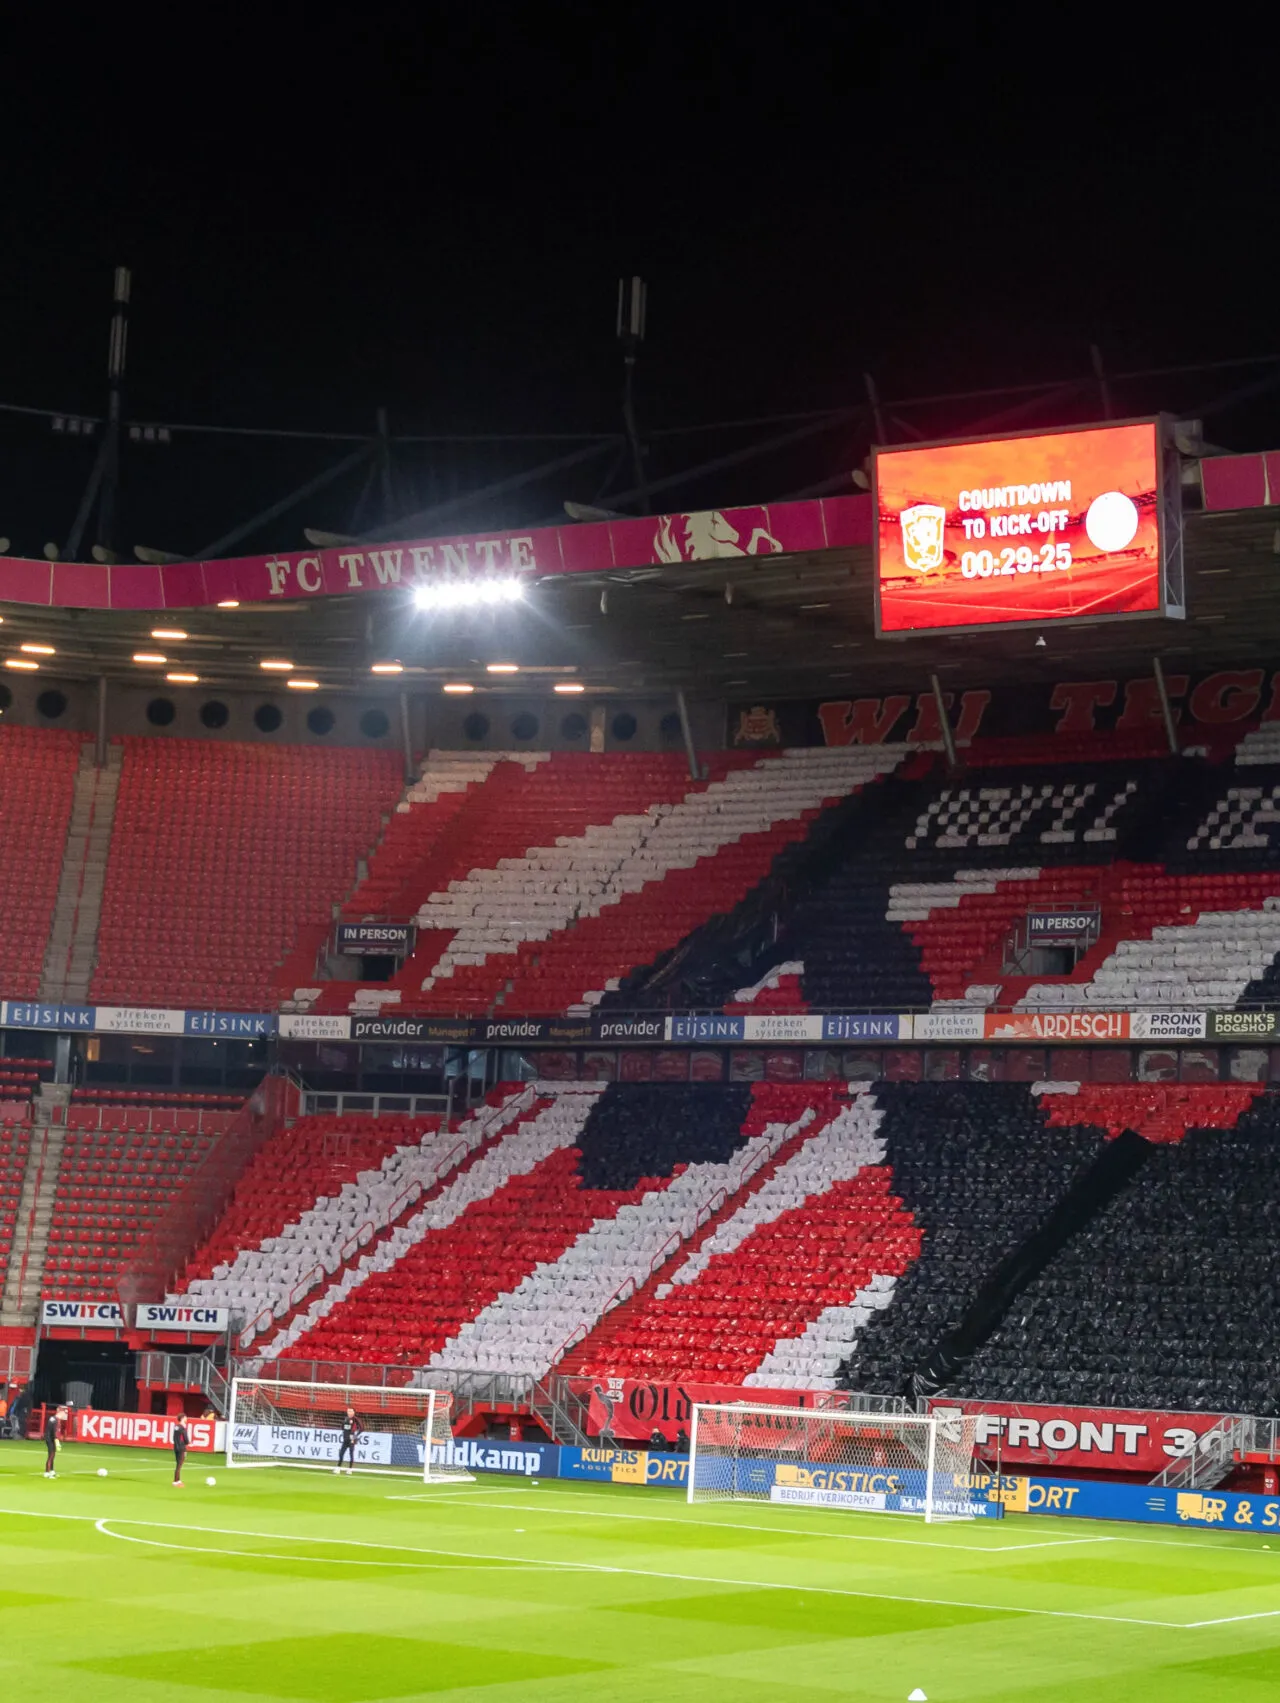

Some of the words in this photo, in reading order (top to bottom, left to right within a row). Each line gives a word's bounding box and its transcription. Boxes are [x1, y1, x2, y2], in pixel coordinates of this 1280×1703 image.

[959, 480, 1071, 512] COUNTDOWN
[963, 519, 985, 539] TO
[990, 510, 1069, 538] KICK-OFF
[266, 558, 321, 595] FC
[339, 537, 536, 587] TWENTE
[961, 543, 1072, 579] 00:29:25
[1032, 918, 1044, 930] IN
[1047, 916, 1096, 929] PERSON
[344, 928, 357, 939] IN
[360, 928, 407, 939] PERSON
[1150, 1014, 1201, 1025] PRONK
[1215, 1014, 1275, 1023] PRONK'S
[355, 1021, 423, 1037] previder
[486, 1020, 541, 1039] previder
[600, 1019, 660, 1037] previder
[1150, 1025, 1201, 1036] montage
[1215, 1024, 1275, 1032] DOGSHOP
[46, 1303, 121, 1319] SWITCH
[147, 1307, 217, 1323] SWITCH
[271, 1427, 310, 1443] Henny
[974, 1416, 1148, 1454] FRONT
[417, 1439, 541, 1475] wildkamp
[582, 1448, 638, 1464] KUIPERS
[1234, 1501, 1254, 1524] &
